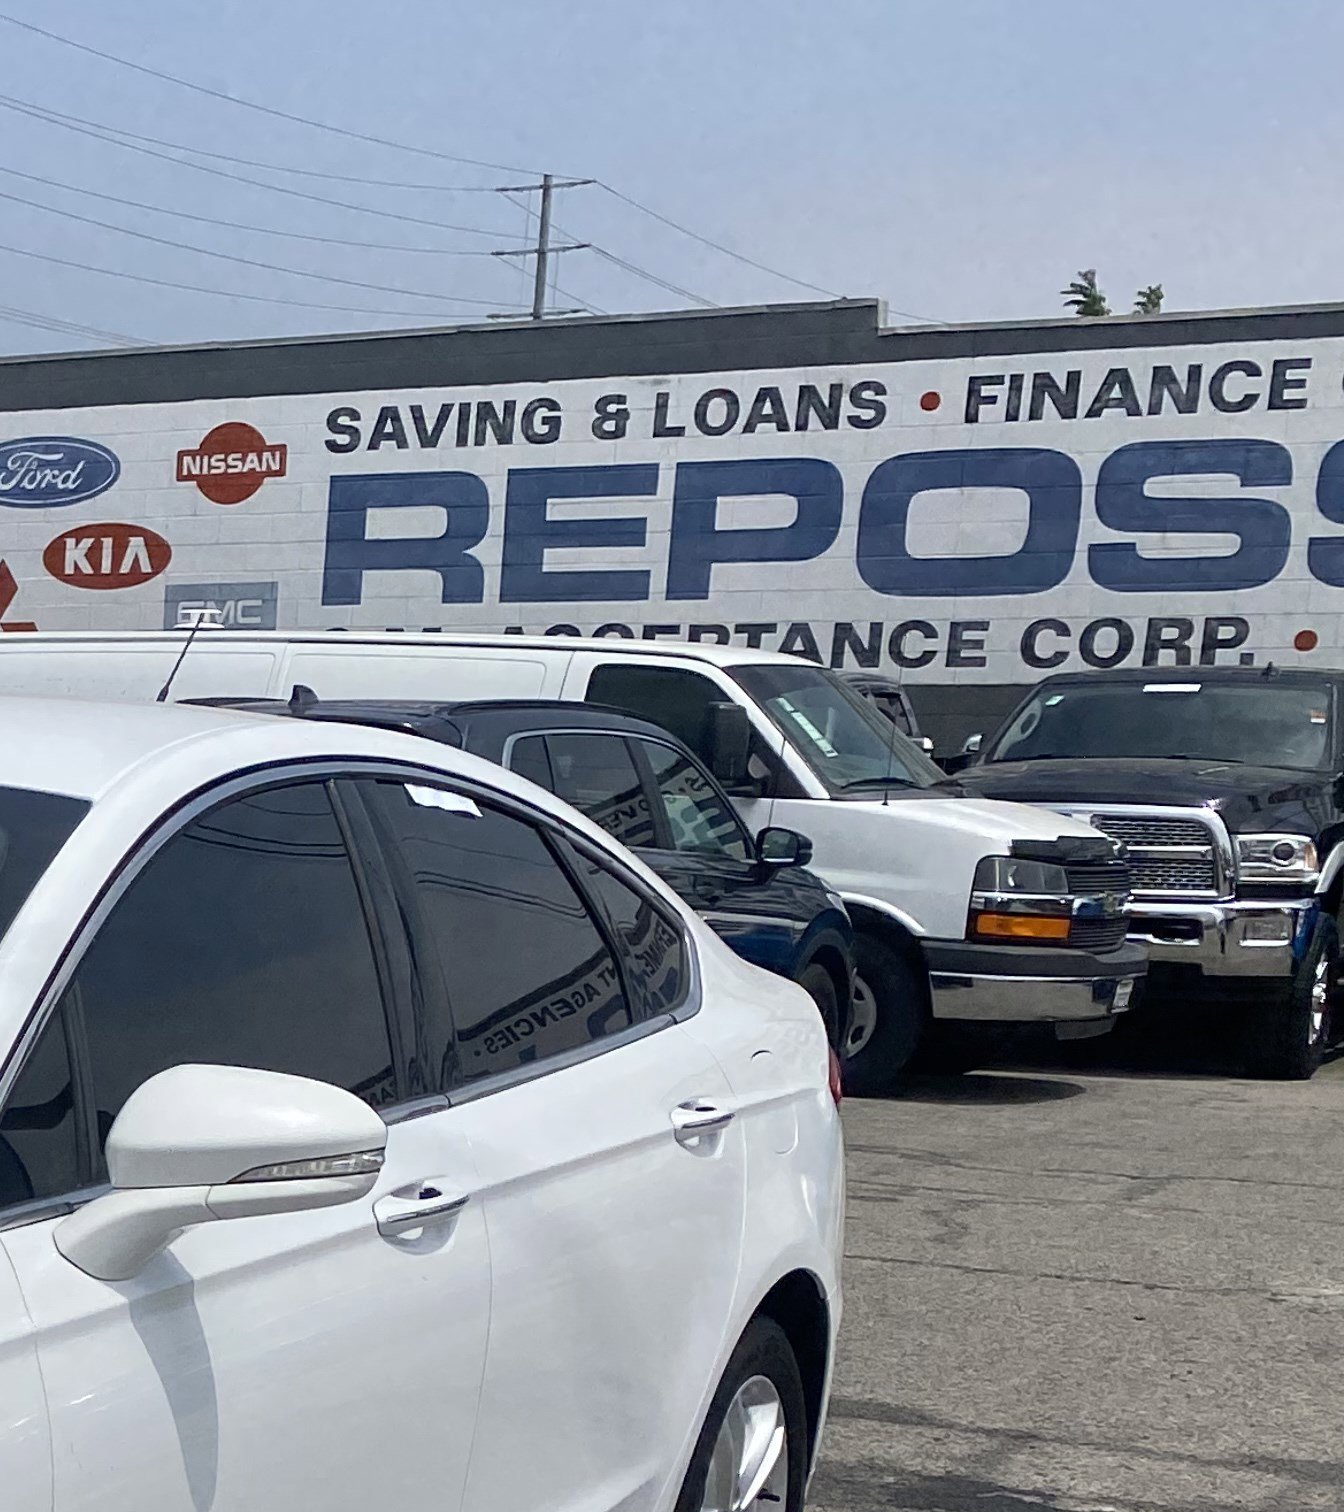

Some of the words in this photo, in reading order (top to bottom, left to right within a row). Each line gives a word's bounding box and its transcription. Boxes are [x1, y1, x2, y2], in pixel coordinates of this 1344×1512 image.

[325, 397, 562, 454] SAVING
[591, 393, 630, 440] &
[652, 379, 888, 440] LOANS
[965, 357, 1313, 424] FINANCE
[181, 449, 282, 477] NISSAN
[322, 438, 1344, 607] REPOS
[63, 536, 153, 576] KIA
[1019, 616, 1256, 670] CORP.
